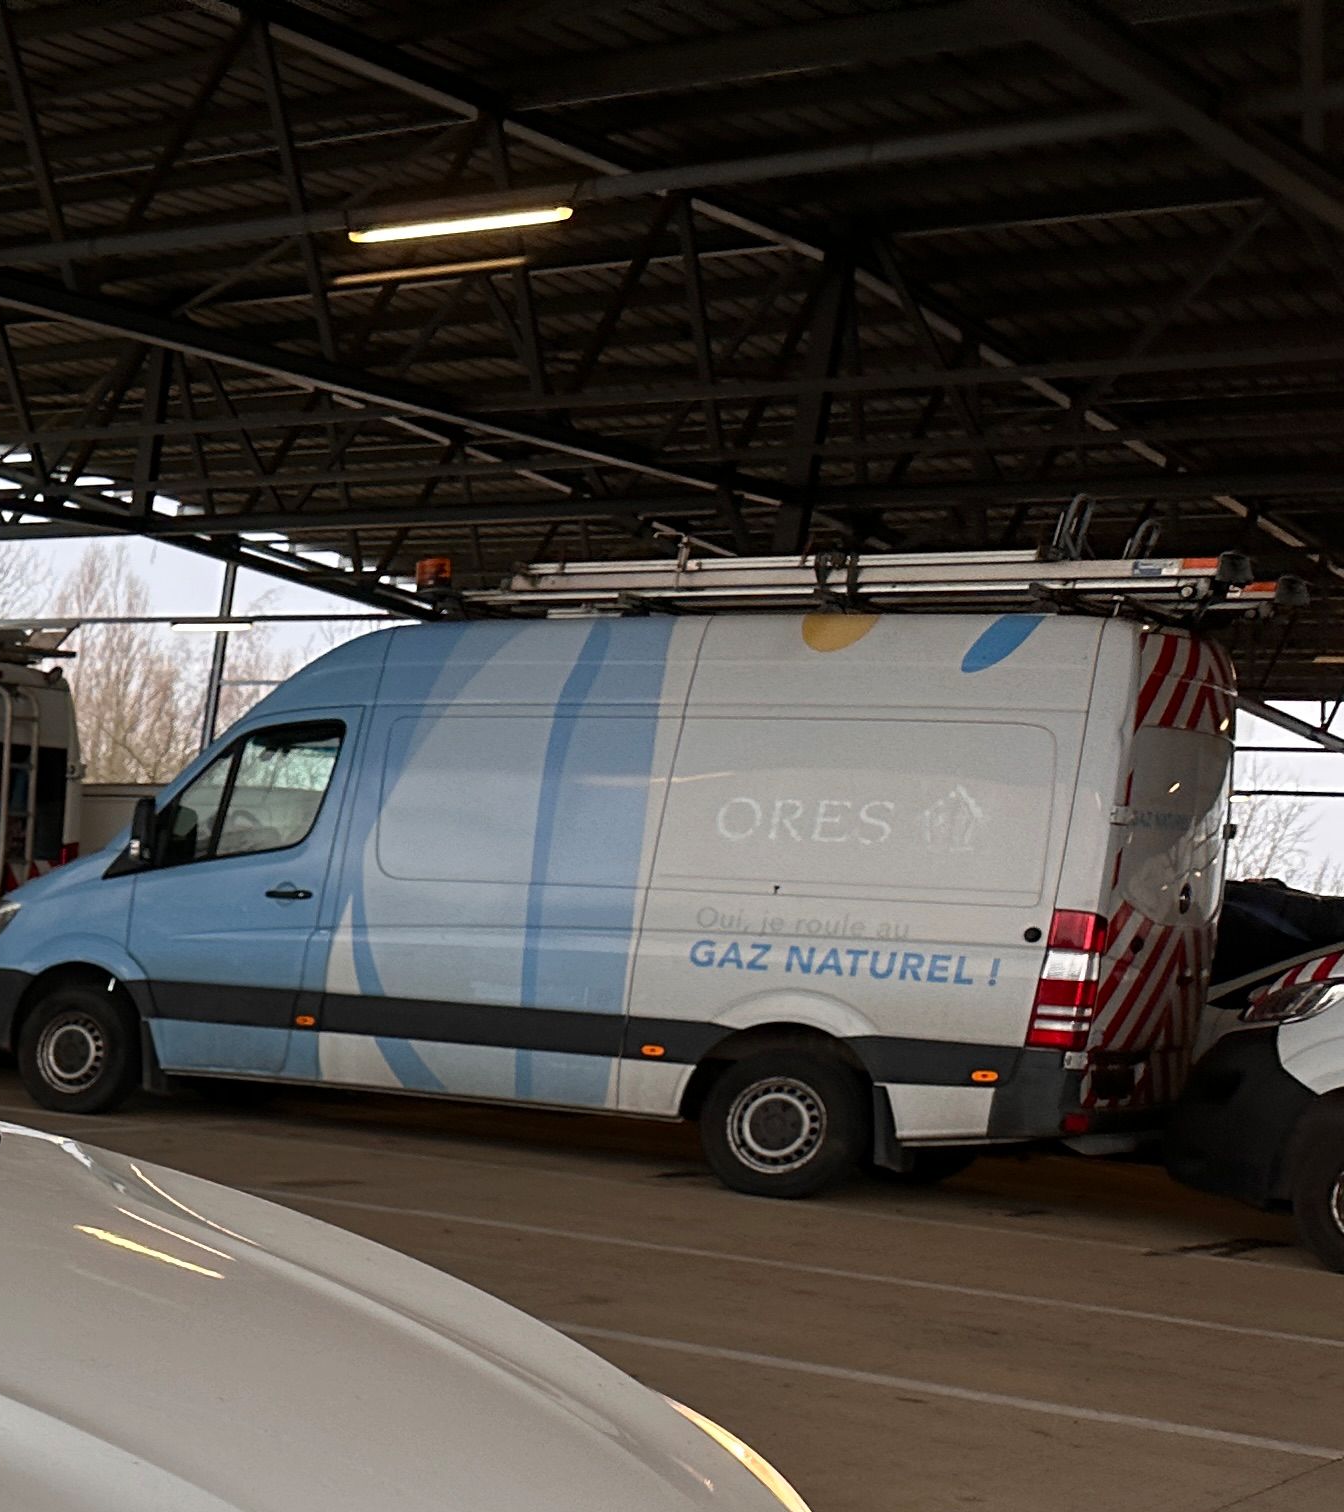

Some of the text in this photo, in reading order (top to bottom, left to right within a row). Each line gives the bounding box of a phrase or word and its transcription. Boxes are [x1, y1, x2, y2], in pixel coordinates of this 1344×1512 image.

[716, 796, 896, 846] ORES
[695, 906, 909, 940] Oui, je roule au
[689, 939, 1001, 986] GAZ NATUREL !
